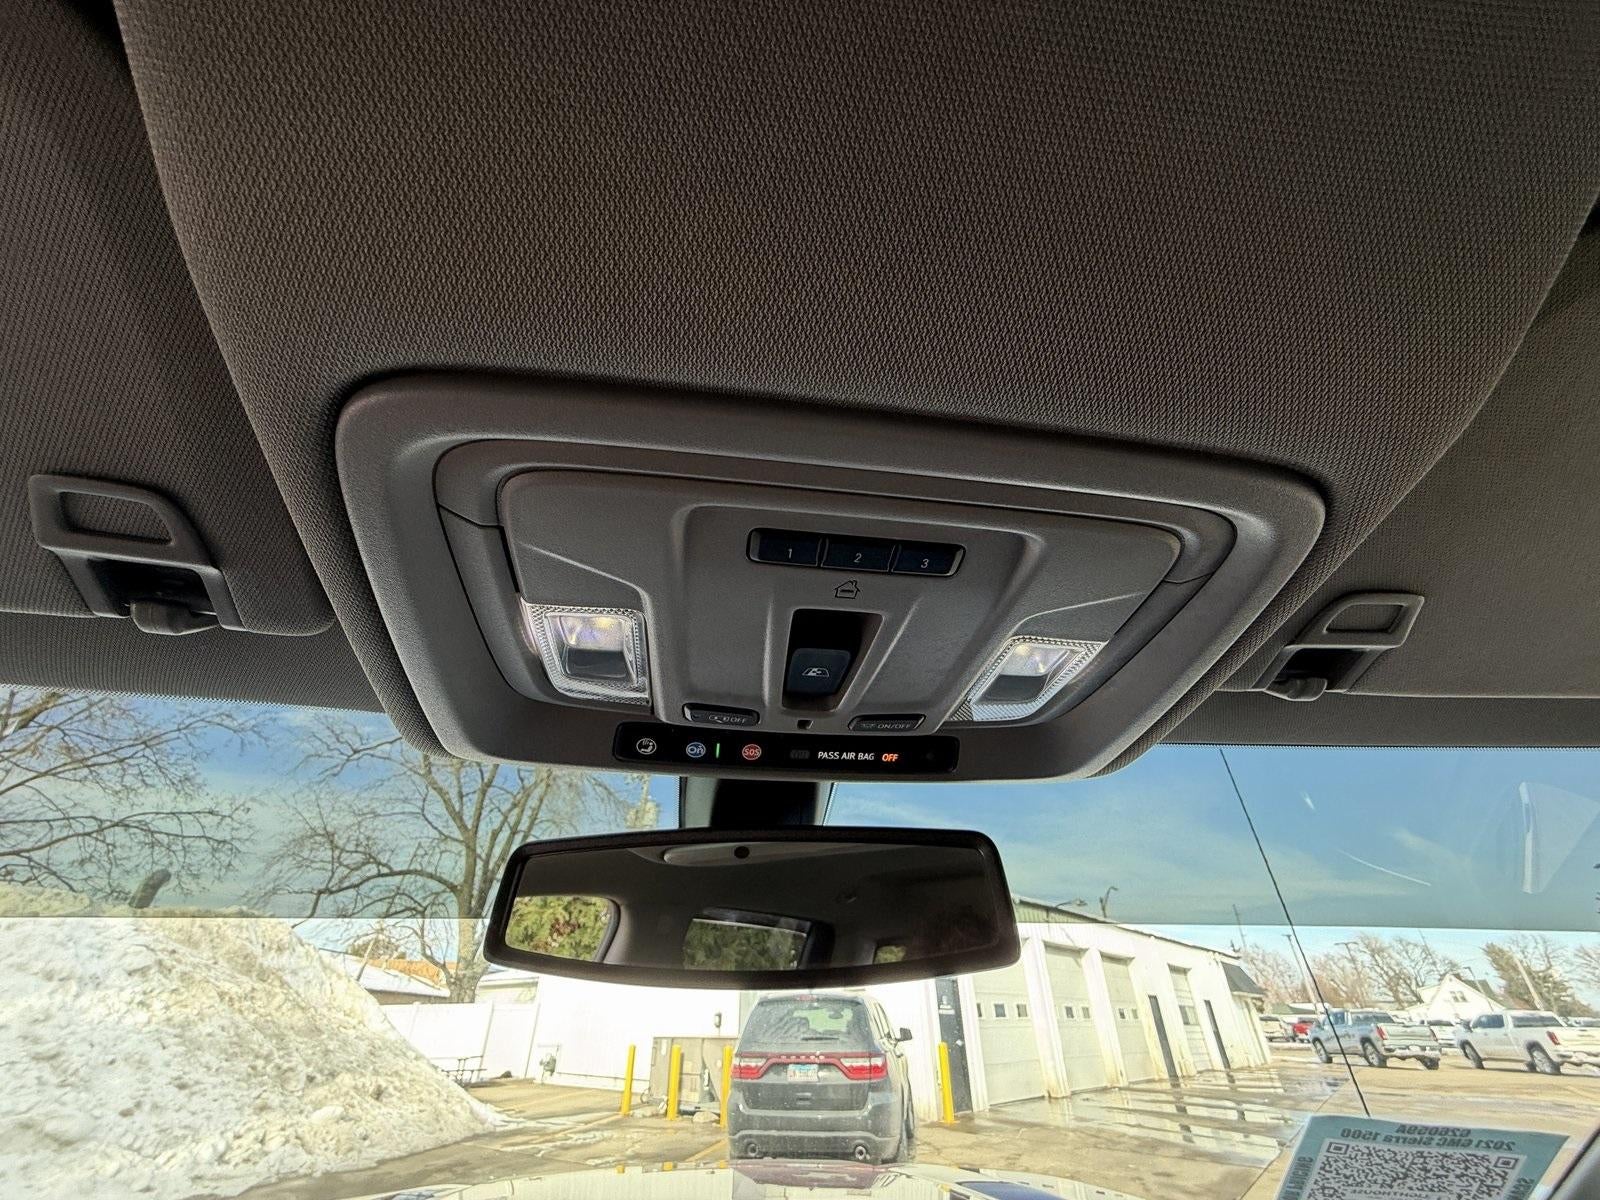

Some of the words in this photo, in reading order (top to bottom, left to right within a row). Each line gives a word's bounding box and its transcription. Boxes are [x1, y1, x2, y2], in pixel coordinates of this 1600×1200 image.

[787, 548, 793, 559] 1
[853, 552, 862, 563] 2
[920, 558, 930, 569] 3
[877, 722, 912, 730] ON/OFF
[745, 748, 760, 756] SOS
[817, 751, 840, 760] PASS
[841, 751, 856, 760] AIR
[858, 752, 875, 761] BAG
[882, 753, 899, 762] OFF
